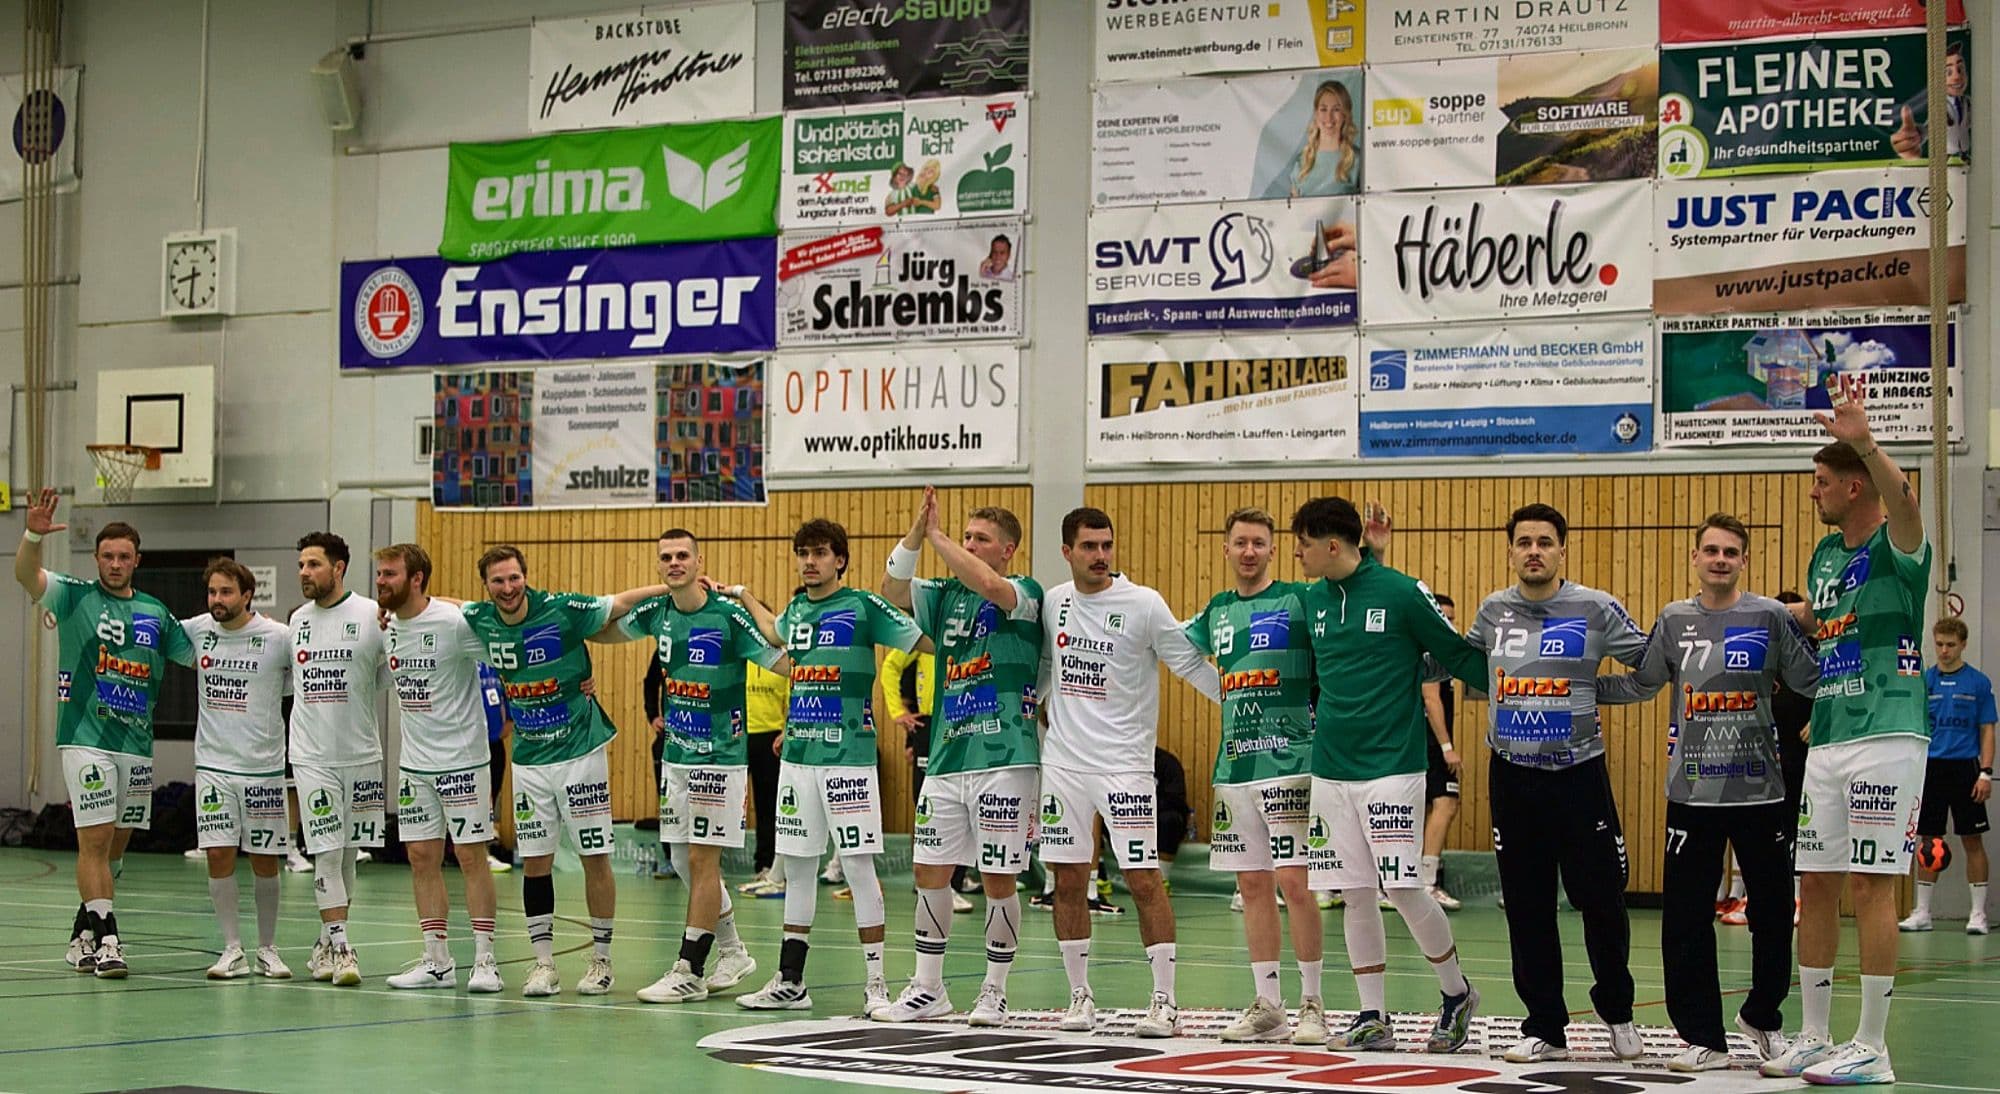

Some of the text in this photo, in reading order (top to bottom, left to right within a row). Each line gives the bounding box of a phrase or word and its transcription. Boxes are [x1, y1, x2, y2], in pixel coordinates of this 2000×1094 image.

[822, 0, 992, 29] eTech Saupp
[1106, 5, 1261, 31] WERBEAGENTUR
[1394, 0, 1629, 28] MARTIN DRAUTZ
[1728, 5, 1913, 31] martin-albrecht-weingut.de
[596, 18, 682, 41] BACKSTUBE
[1483, 28, 1499, 40] 77
[1516, 24, 1555, 37] 74074
[1559, 20, 1630, 34] HEILBRONN
[795, 38, 900, 57] Elektroinstallationen
[1107, 38, 1304, 63] www.steinmetz-werbung.de Flein
[1480, 35, 1563, 51] 07131/176133
[795, 54, 856, 69] Smart Home
[795, 66, 886, 83] Tel. 07131 8992306
[1697, 47, 1894, 98] FLEINER
[794, 78, 900, 96] www.etech-saupp.de
[1429, 93, 1486, 111] soppe
[1537, 101, 1630, 121] SOFTWARE
[1097, 114, 1180, 129] DEINE EXPERTIN FÜR
[1375, 106, 1412, 125] sup
[1429, 110, 1486, 126] +partner
[1557, 115, 1645, 131] WEINWIRTSCHAFT
[1714, 97, 1895, 136] APOTHEKE
[798, 118, 900, 147] Und plötzlich
[907, 116, 969, 138] Augen-
[1097, 127, 1148, 139] GESUNDHEIT
[1156, 123, 1222, 135] WOHLBEFINDEN
[921, 138, 955, 157] licht
[1372, 133, 1486, 149] www.soppe-partner.de
[1714, 139, 1881, 160] Ihr Gesundheitspartner
[798, 141, 896, 165] schenkst du
[471, 159, 645, 222] erima
[1667, 186, 1916, 230] JUST PACK
[1670, 224, 1917, 248] Systempartner für Verpackungen
[1095, 236, 1201, 268] SWT
[900, 250, 956, 289] Jürg
[1715, 257, 1912, 298] www.justpack.de
[1095, 272, 1201, 291] SERVICES
[436, 264, 762, 349] Ensinger
[812, 275, 1004, 331] Schrembs
[1500, 288, 1608, 309] Ihre Metzgerei
[1096, 302, 1352, 325] Flexodruck-, Spann- und Auswuchttechnologie
[1662, 320, 1681, 331] IHR
[1682, 318, 1729, 331] STARKER
[1732, 317, 1780, 329] PARTNER
[1788, 316, 1804, 328] Mit
[1806, 317, 1822, 327] uns
[1823, 315, 1862, 327] bleiben
[1864, 313, 1881, 325] Sie
[1883, 312, 1915, 324] immer
[1414, 340, 1644, 361] ZIMMERMANN und BECKER GmbH
[1413, 356, 1643, 374] Beratende Ingenieure für Technische Gebäudeausrüstung
[597, 371, 637, 382] Jalousien
[1371, 374, 1390, 390] ZB
[1413, 375, 1646, 391] Sanitär Heizung Lüftung Klima Gebäudeautomation
[1869, 369, 1931, 384] MÜNZING
[541, 386, 648, 402] Klappladen Schiebeladen
[785, 363, 1007, 415] OPTIKHAUS
[1101, 355, 1349, 419] FAHRERLAGER
[1223, 381, 1348, 415] mehr als nur FAHRSCHULE
[541, 402, 648, 417] Markisen Insektenschutz
[568, 419, 620, 432] Sonnensegel
[1369, 415, 1536, 430] Heilbronn Hamburg Leipzig Stockach
[804, 424, 983, 460] www.optikhaus.hn
[1100, 427, 1347, 442] Flein Heilbronn Nordheim Lauffen Leingarten
[1369, 431, 1577, 449] www.zimmermannundbecker.de
[1674, 428, 1818, 441] FLASCHNEREI HEIZUNG UND VIELES
[565, 464, 650, 491] schulze
[1071, 636, 1115, 653] PFITZER
[1490, 626, 1529, 659] 12
[1541, 639, 1566, 656] ZB
[215, 659, 259, 671] PFITZER
[312, 649, 353, 661] PFITZER
[488, 642, 519, 671] 65
[1060, 654, 1107, 675] Kühner
[1678, 639, 1713, 673] 77
[1726, 650, 1750, 669] ZB
[302, 667, 347, 680] Kühner
[1061, 669, 1108, 688] Sanitär
[1220, 666, 1281, 701] jonas
[302, 679, 348, 693] Sanitär
[1496, 666, 1572, 704] jonas
[1683, 681, 1758, 722] jonas
[825, 776, 869, 791] Kühner
[826, 789, 871, 804] Sanitär
[121, 805, 146, 824] 23
[979, 805, 1020, 821] Sanitär
[1367, 802, 1414, 817] Kühner
[1369, 815, 1415, 831] Sanitär
[250, 829, 274, 849] 27
[579, 826, 604, 850] 65
[836, 825, 860, 850] 19
[981, 842, 1006, 868] 24
[1850, 838, 1877, 866] 10
[732, 1028, 1698, 1094] MOCOS
[756, 1056, 1034, 1082] Mobilfunk.
